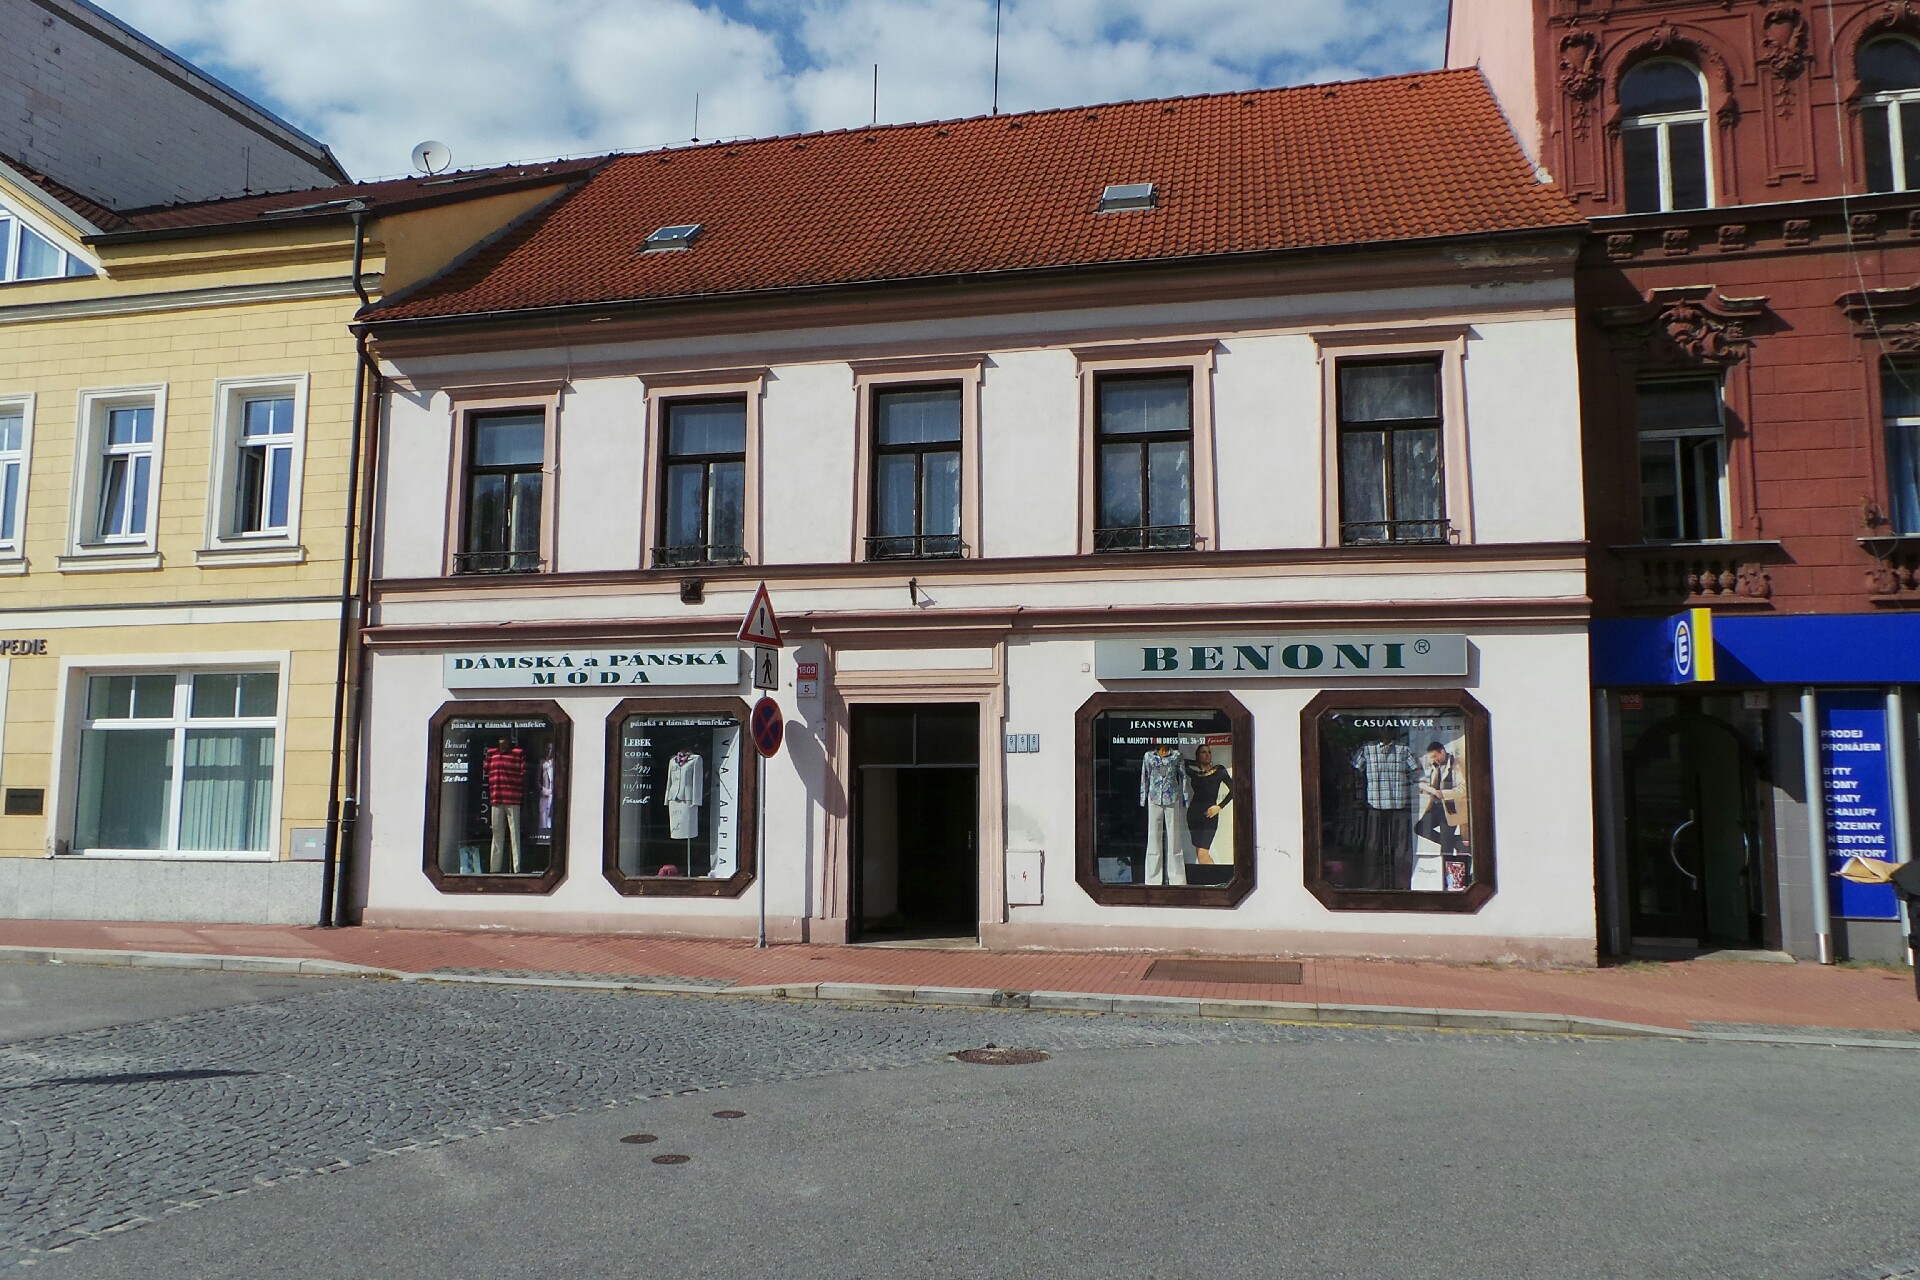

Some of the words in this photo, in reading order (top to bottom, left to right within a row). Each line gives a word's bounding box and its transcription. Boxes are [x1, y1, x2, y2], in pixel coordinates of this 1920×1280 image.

[0, 639, 48, 655] PEDIE
[454, 654, 574, 670] DÁMSKÁ
[583, 658, 599, 667] a
[609, 650, 728, 667] PÁNSKÁ
[804, 684, 810, 693] 5
[451, 721, 476, 730] pánská
[484, 721, 512, 729] dámská
[630, 720, 657, 729] pánská
[1130, 720, 1194, 729] JEANSWEAR
[1354, 719, 1434, 728] CASUALWEAR
[1820, 730, 1863, 739] PRODEJ
[624, 738, 651, 747] LEBEK
[1821, 742, 1881, 752] PRONÁJEM
[1823, 767, 1852, 776] BYTY
[1825, 780, 1858, 789] DOMY
[1825, 794, 1861, 803] CHATY
[1826, 808, 1877, 817] CHALUPY
[1827, 822, 1882, 831] POZEMKY
[1828, 834, 1885, 844] NEBYTOVÉ
[1828, 849, 1887, 858] PROSTORY
